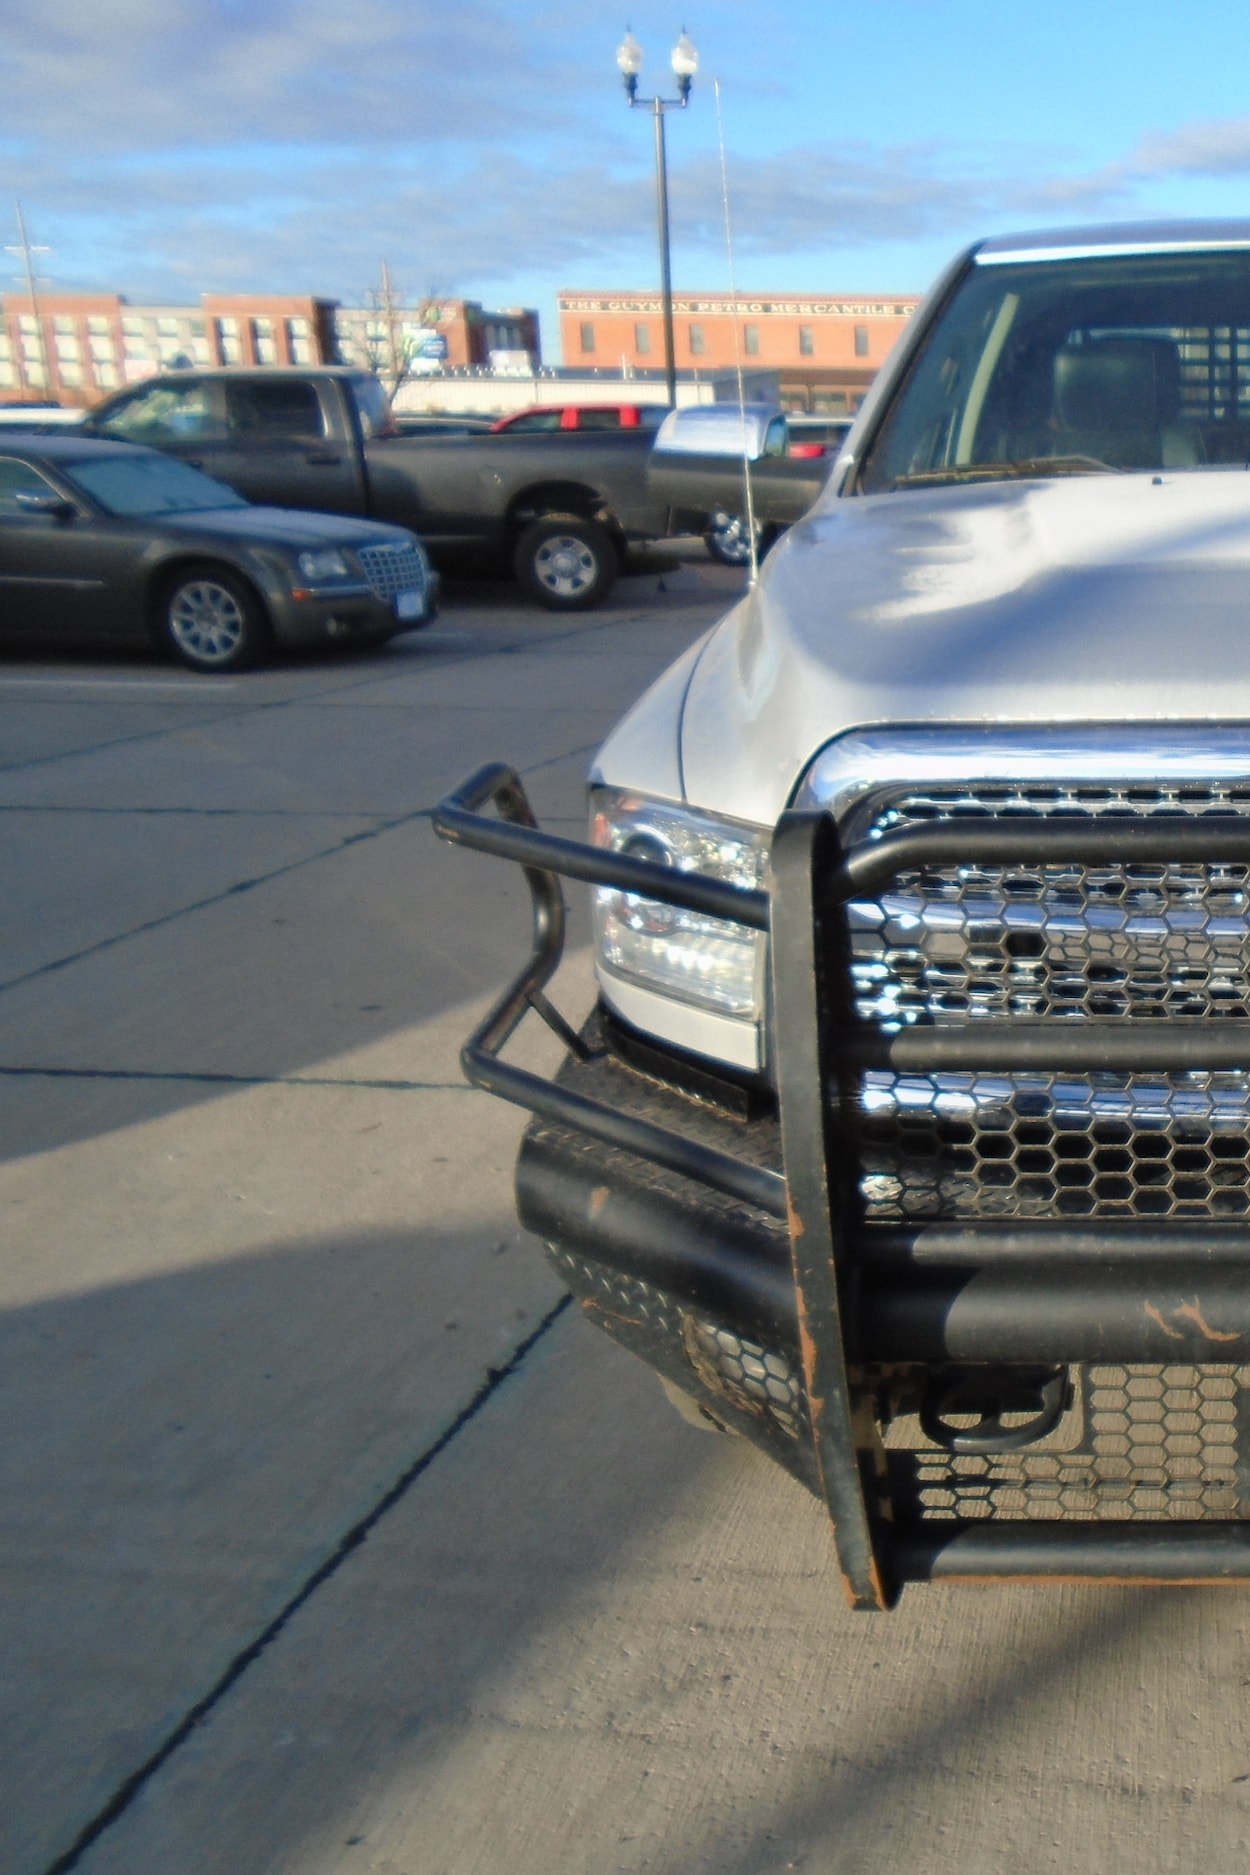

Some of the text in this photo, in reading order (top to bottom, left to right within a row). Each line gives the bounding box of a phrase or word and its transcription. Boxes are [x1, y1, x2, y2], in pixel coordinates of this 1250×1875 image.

[566, 301, 600, 310] THE
[697, 303, 762, 312] PETRO
[770, 303, 894, 314] MERCANTILE
[903, 305, 915, 314] C
